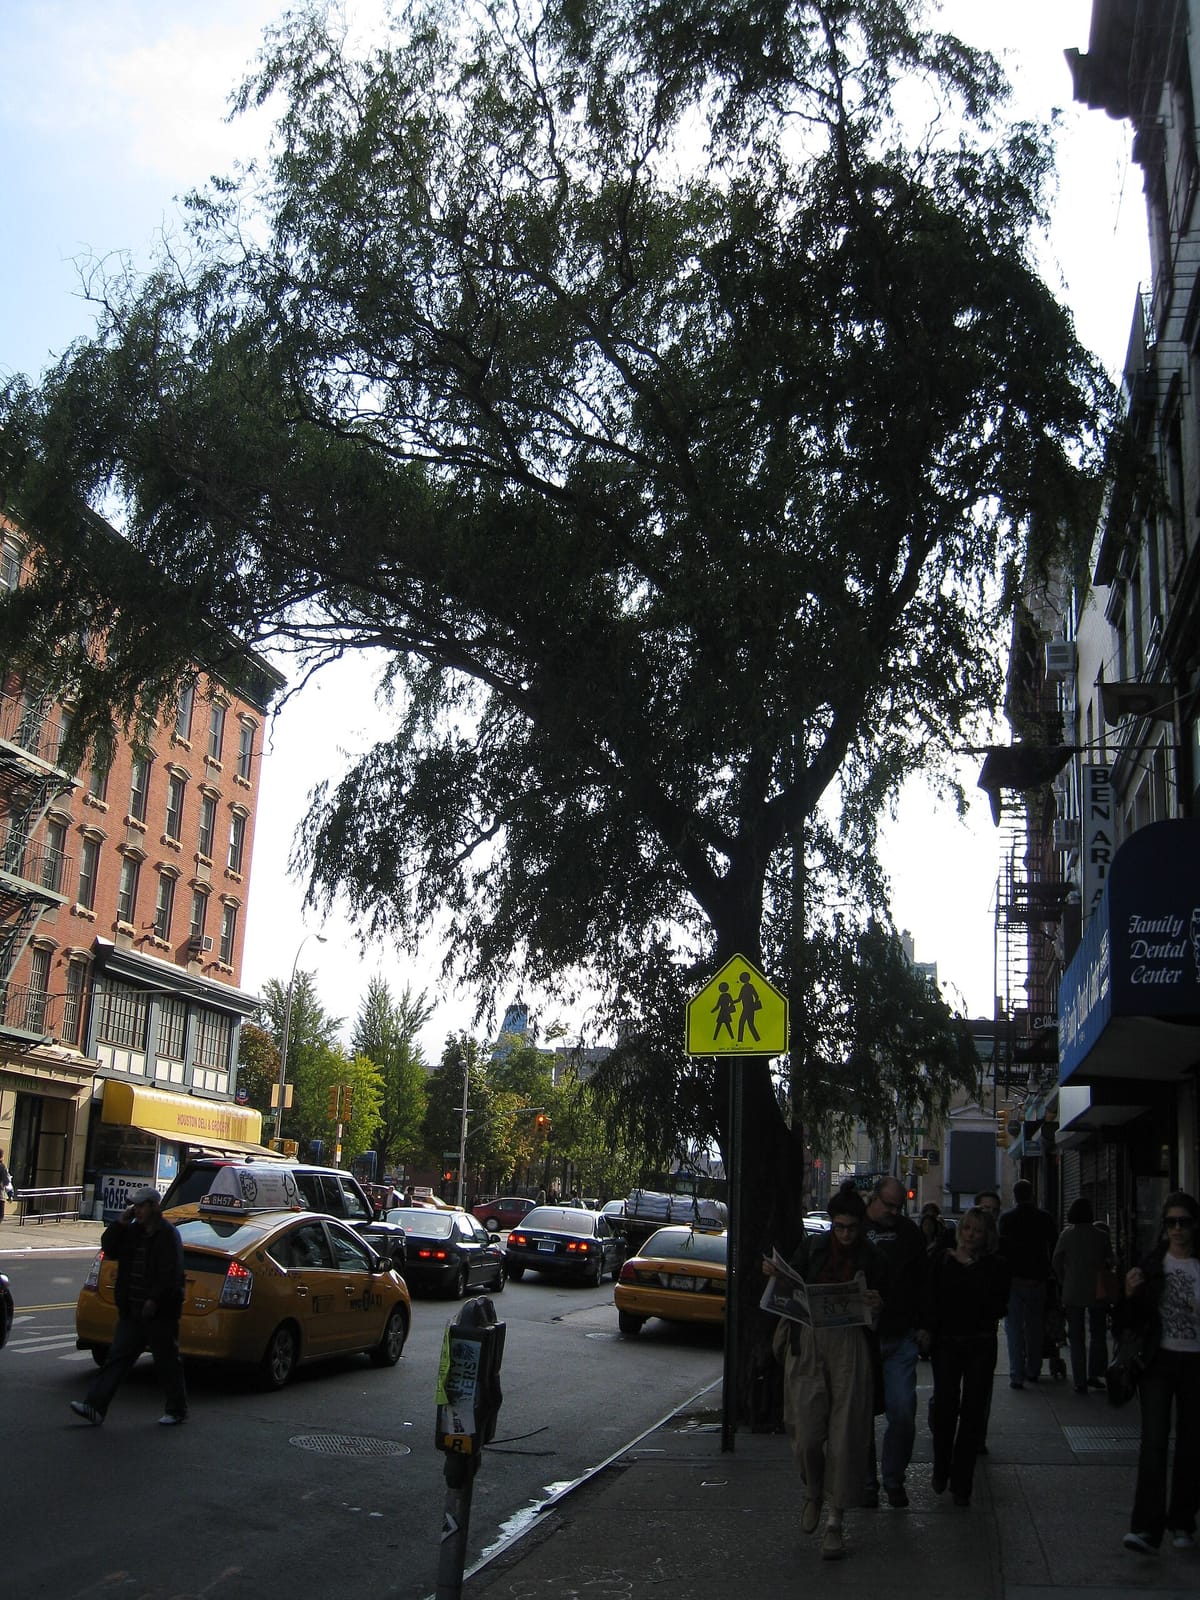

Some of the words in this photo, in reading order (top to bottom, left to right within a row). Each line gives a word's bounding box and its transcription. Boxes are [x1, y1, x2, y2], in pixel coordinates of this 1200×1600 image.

[1091, 769, 1110, 820] BEN
[1091, 830, 1111, 879] ARI
[1128, 914, 1184, 937] Family
[1130, 938, 1187, 960] Dental
[1130, 964, 1182, 984] Center
[177, 1113, 197, 1128] HOUSTON
[108, 1178, 115, 1186] 2
[119, 1179, 149, 1188] Dozen
[103, 1187, 129, 1209] ROSES
